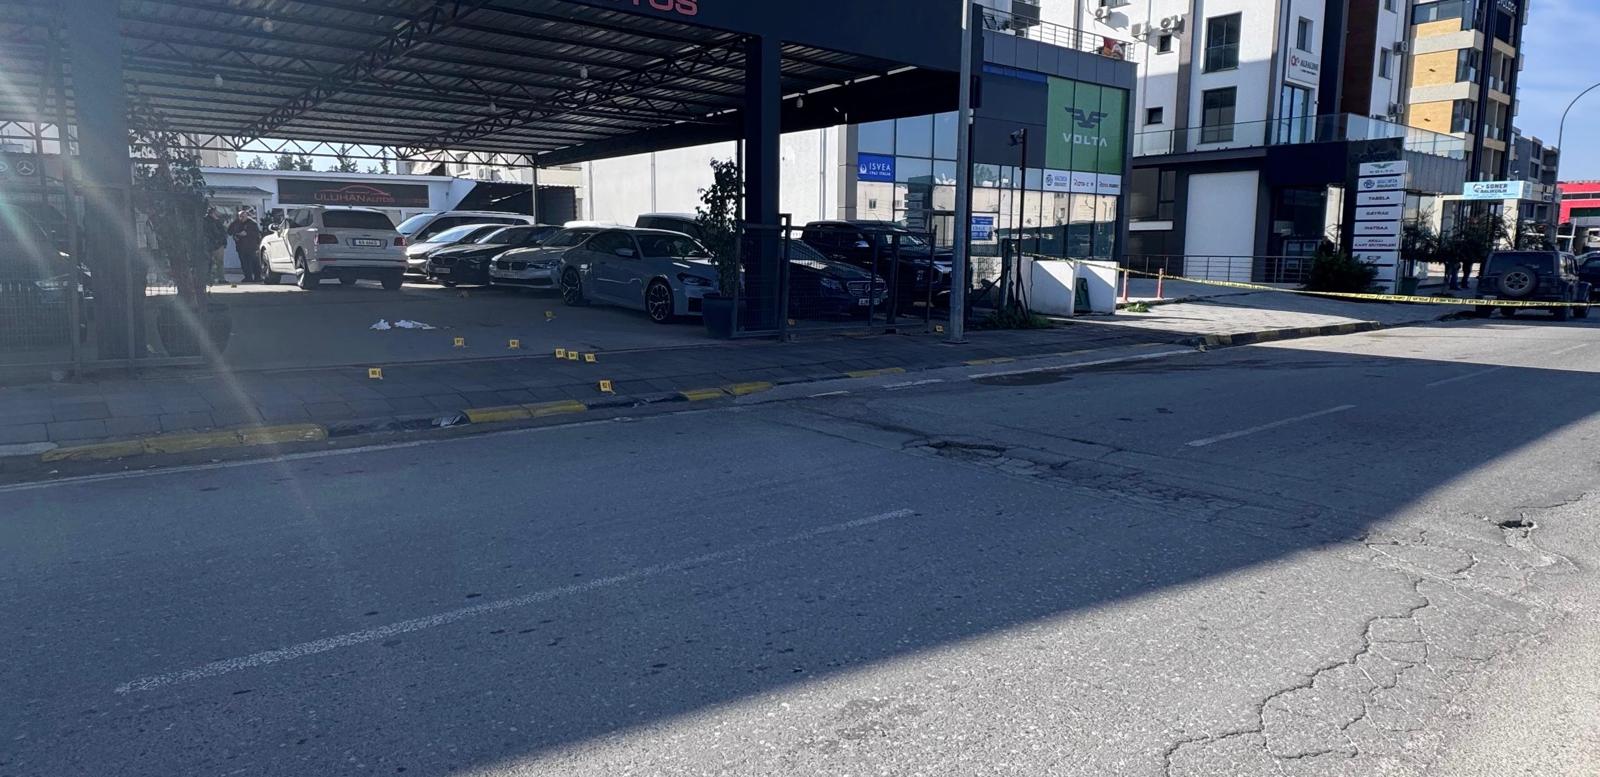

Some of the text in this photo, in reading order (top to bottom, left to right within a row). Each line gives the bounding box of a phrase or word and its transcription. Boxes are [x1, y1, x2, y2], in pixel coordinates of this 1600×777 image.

[632, 0, 698, 15] OS
[1063, 133, 1107, 147] VOLTA
[869, 162, 891, 171] ISVEA
[314, 192, 366, 202] ULUHAN
